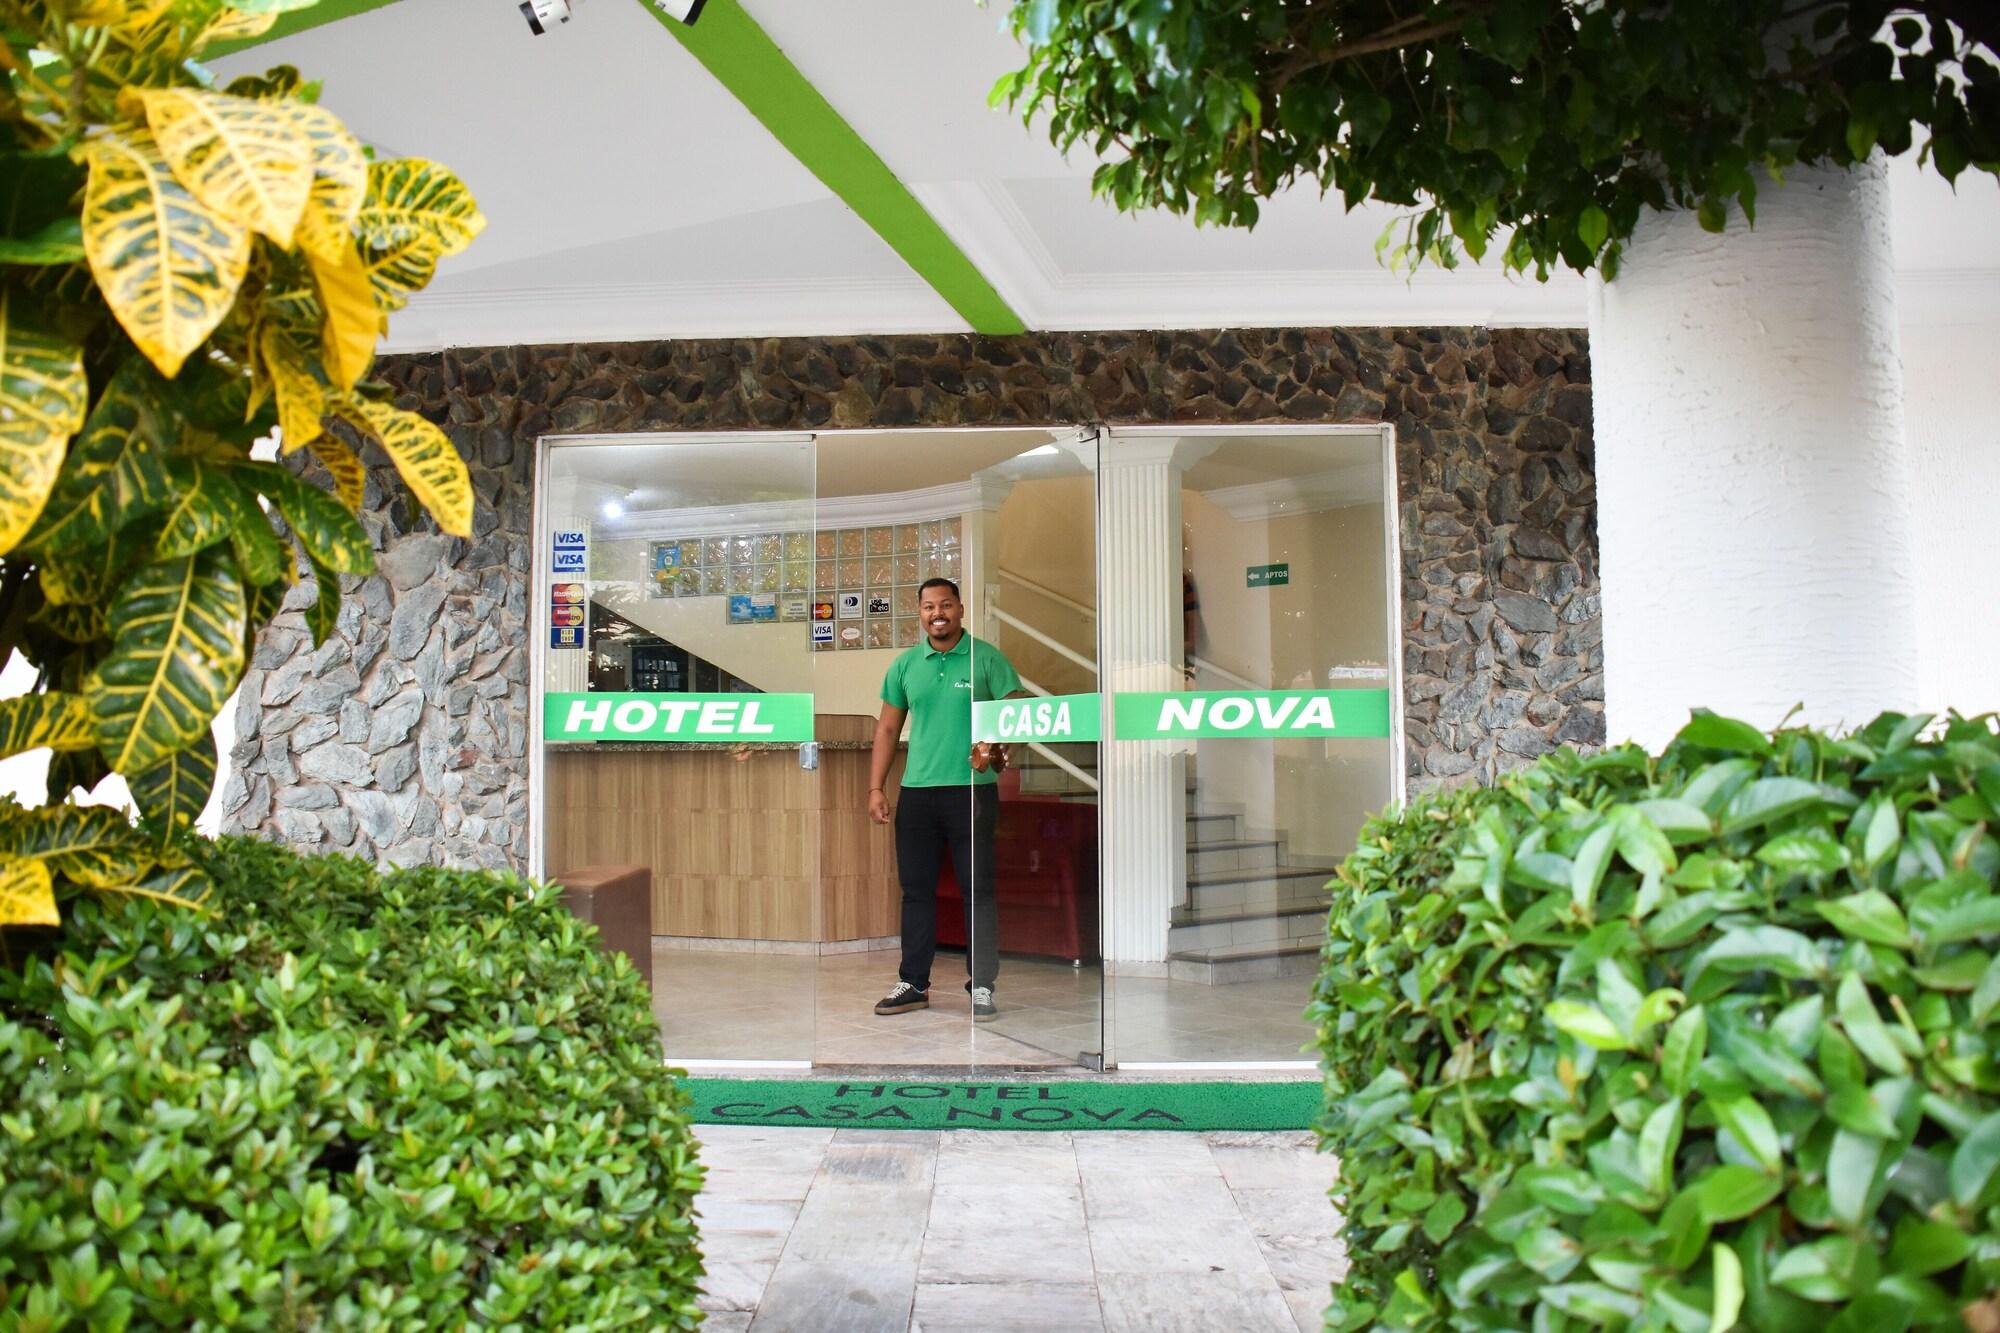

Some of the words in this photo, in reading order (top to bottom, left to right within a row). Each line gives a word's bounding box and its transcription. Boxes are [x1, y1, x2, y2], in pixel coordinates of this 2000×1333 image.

[558, 533, 584, 543] VISA
[557, 554, 583, 564] VISA
[1264, 570, 1288, 579] APTOS
[813, 626, 831, 634] VISA
[564, 700, 774, 734] HOTEL
[999, 701, 1072, 737] CASA
[1157, 697, 1336, 731] NOVA
[834, 1084, 1069, 1100] HOTEL
[711, 1103, 913, 1121] CASA
[946, 1106, 1186, 1123] NOVA
